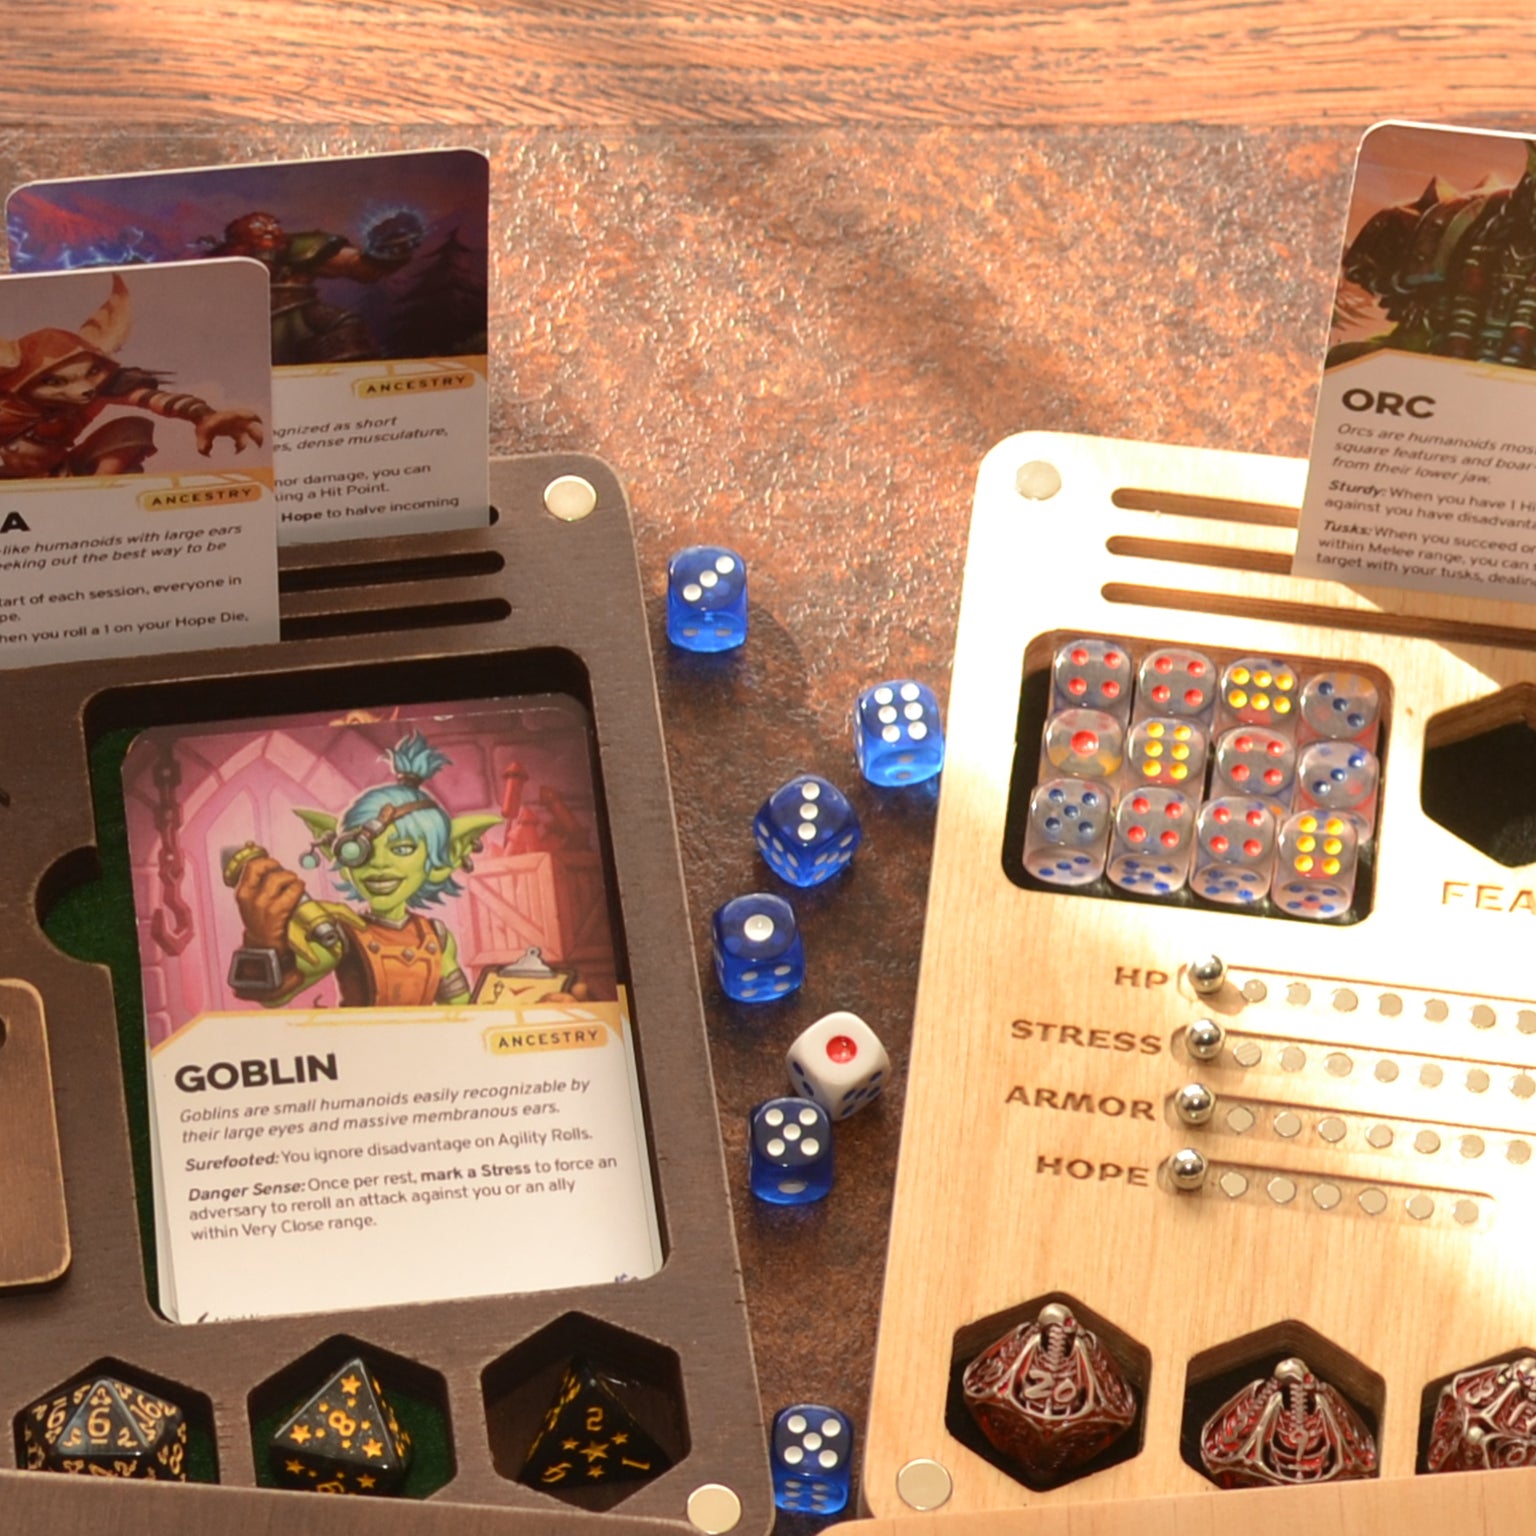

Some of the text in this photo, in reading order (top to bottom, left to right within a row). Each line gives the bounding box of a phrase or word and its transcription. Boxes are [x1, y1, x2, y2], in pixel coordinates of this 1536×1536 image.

[366, 375, 465, 394] ANCESTRY
[1341, 388, 1436, 419] ORC
[296, 437, 345, 450] dense
[372, 468, 401, 481] you
[403, 465, 431, 476] can
[151, 488, 252, 506] ANCESTRY
[281, 497, 460, 523] Hope to halve incoming
[1324, 498, 1381, 513] against
[1385, 505, 1414, 518] you
[1416, 507, 1454, 521] have
[34, 535, 123, 553] humanoids
[126, 531, 161, 545] with
[164, 529, 205, 542] large
[207, 525, 242, 537] ears
[29, 593, 45, 605] of
[48, 590, 86, 604] each
[152, 578, 225, 594] everyone
[228, 576, 242, 586] in
[1114, 966, 1169, 991] HP
[498, 1029, 599, 1049] ANCESTRY
[1011, 1019, 1162, 1056] STRESS
[174, 1052, 338, 1093] GOBLIN
[179, 1078, 591, 1124] Goblins are small humanoids easily recognizable by
[1005, 1085, 1155, 1122] ARMOR
[182, 1102, 560, 1144] their large eyes and massive membranous ears.
[184, 1127, 593, 1173] Surefooted: You ignore disadvantage on Agility Rolls.
[187, 1157, 618, 1202] Danger Sense: Once per rest, mark a Stress to force an
[1036, 1155, 1149, 1188] HOPE
[188, 1177, 576, 1221] adversary to reroll an attack against you or an ally
[190, 1216, 377, 1241] within Very Close range.
